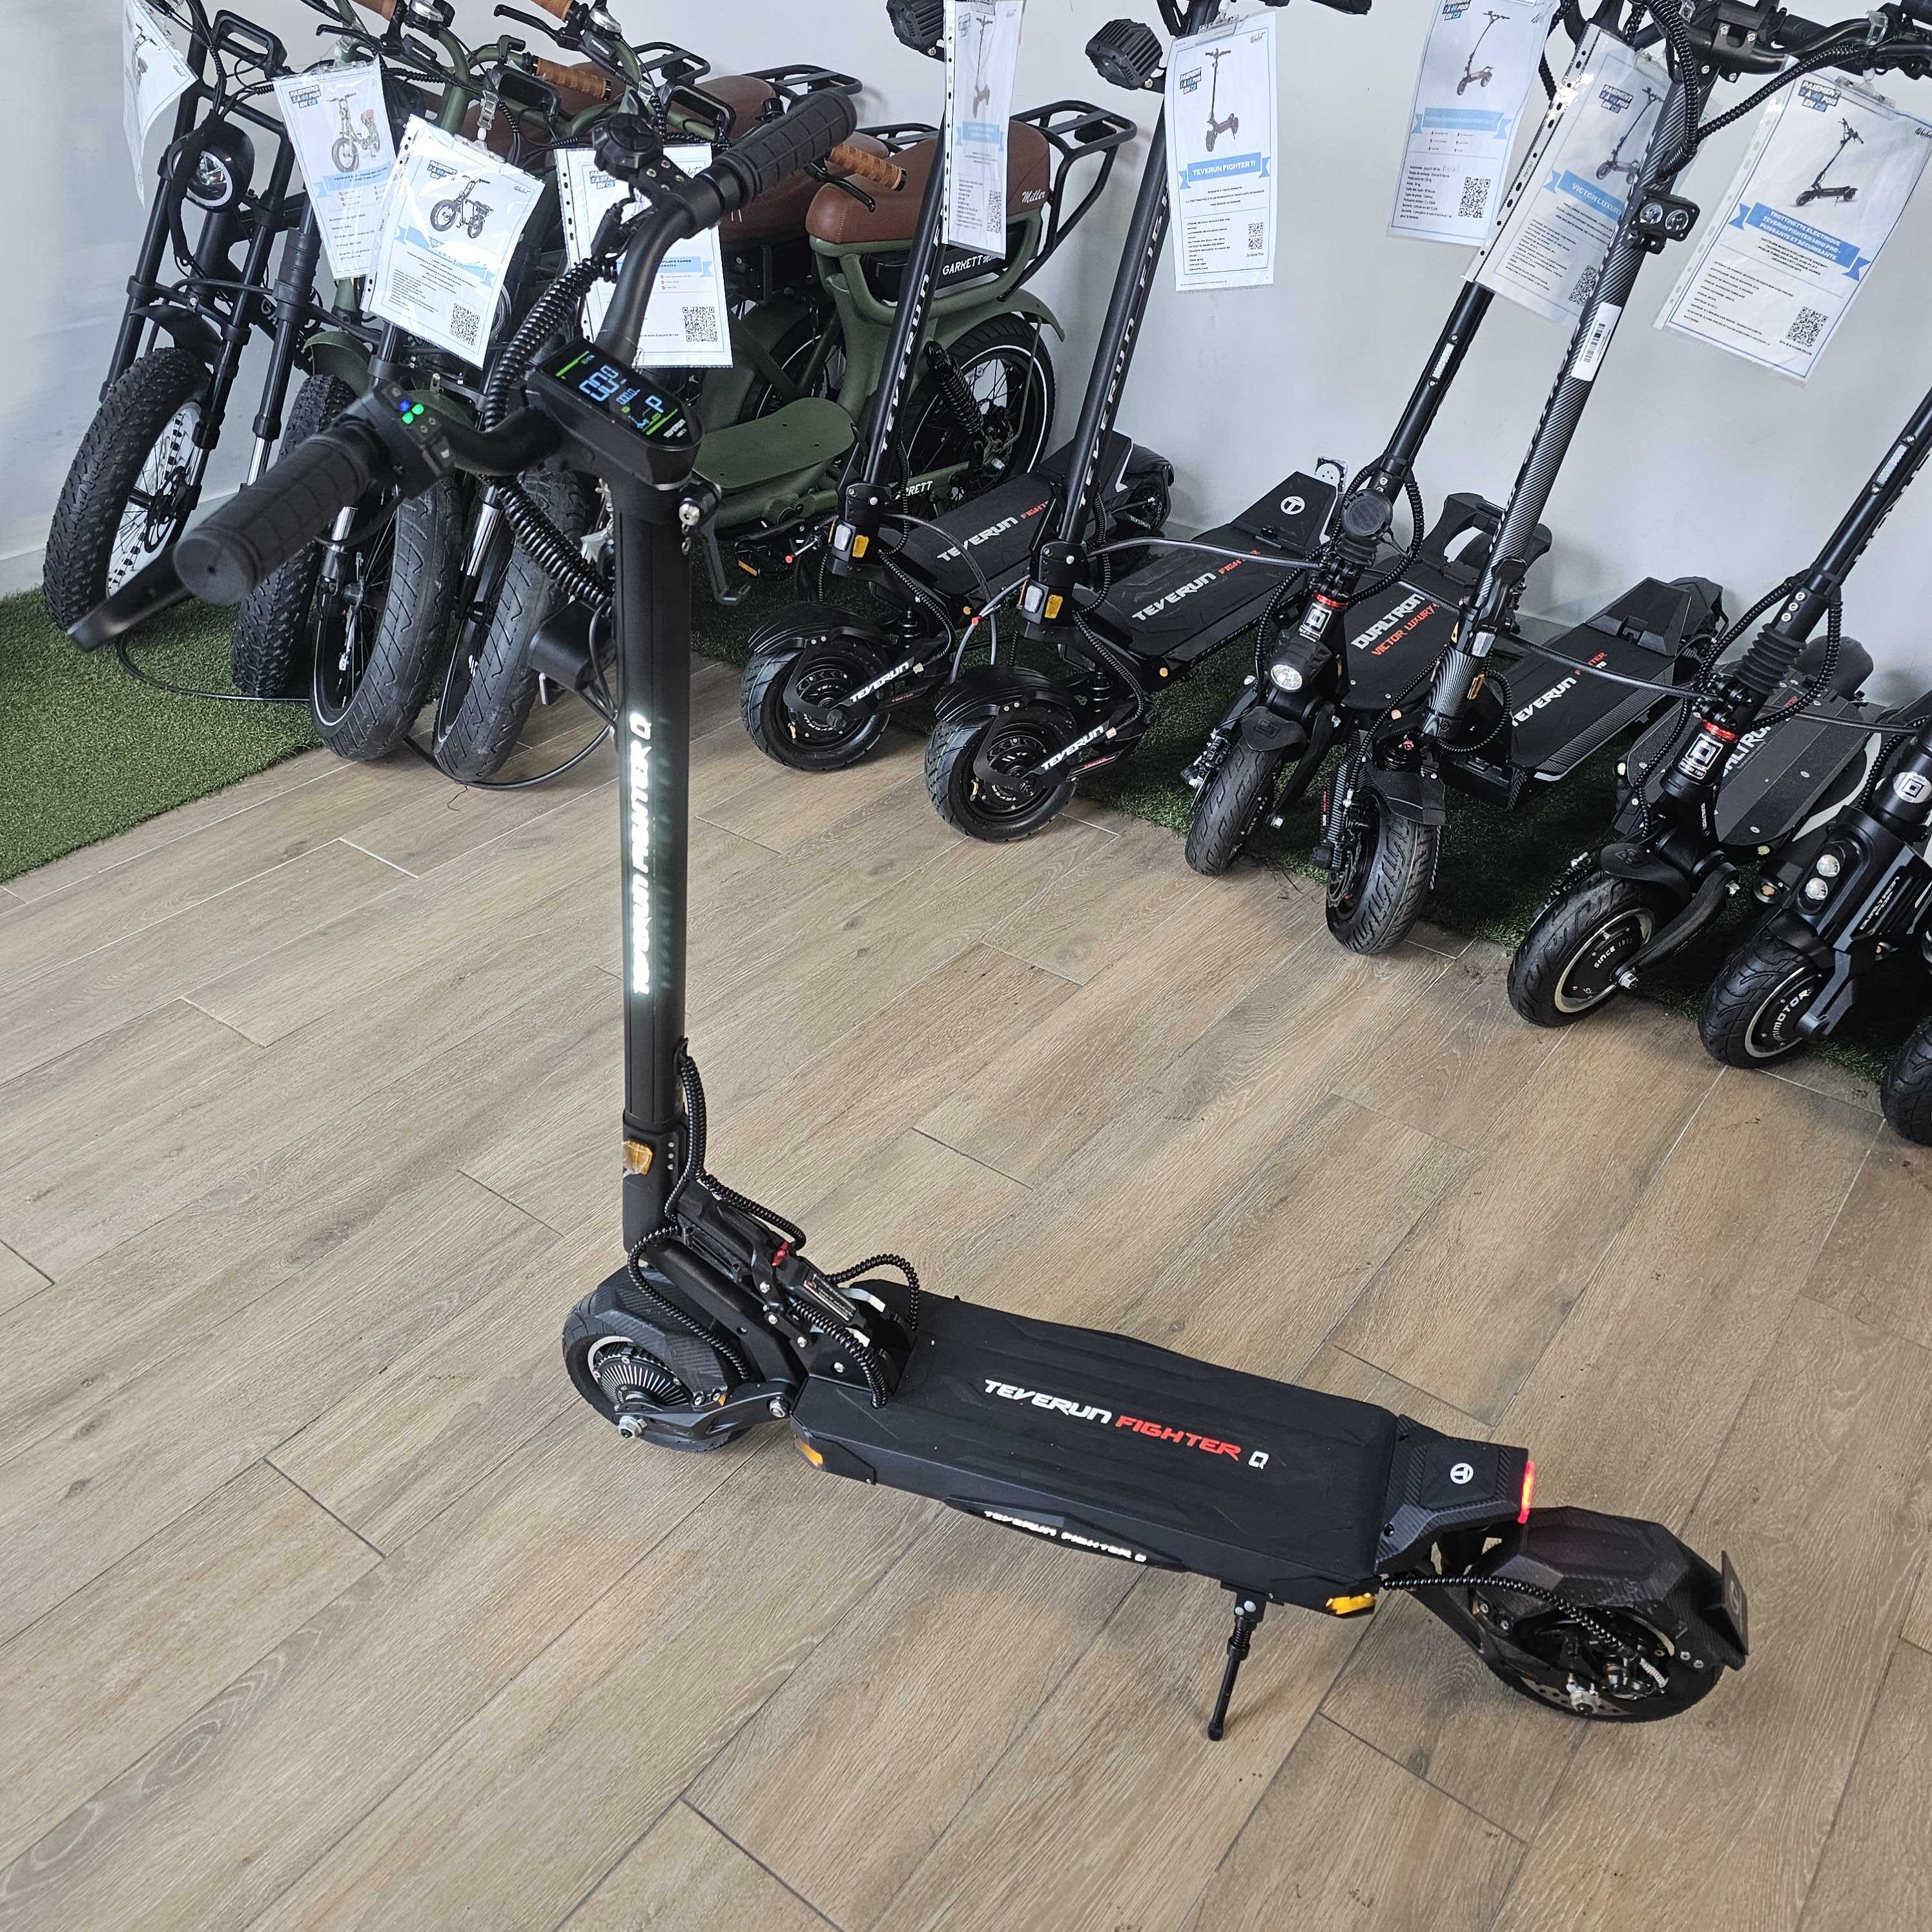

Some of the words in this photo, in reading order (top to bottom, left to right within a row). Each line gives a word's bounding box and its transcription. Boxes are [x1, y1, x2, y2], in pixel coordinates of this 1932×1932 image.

[1802, 81, 1841, 98] PAIEMENT
[1803, 99, 1816, 108] EN
[1821, 96, 1838, 106] FOIS
[1193, 165, 1222, 176] TEVERUN
[1222, 161, 1250, 171] FIGHTER
[1022, 189, 1045, 203] Miller
[1572, 182, 1597, 203] VICTOR
[1762, 216, 1789, 232] TEVERUN
[1770, 211, 1807, 231] TROTTINETTE
[1806, 225, 1842, 246] ÉLECTRIQUE
[880, 273, 930, 454] TEVERUN
[1078, 317, 1135, 510] TEVERUN
[1020, 500, 1049, 520] FIGHT
[1131, 571, 1217, 622] TEVERUN
[1350, 593, 1426, 650] DUALTRON
[1371, 630, 1408, 657] VICTOR
[849, 661, 909, 703] TEVERUN
[1041, 725, 1104, 771] TEVERUN
[984, 1379, 1113, 1424] TEVERUN
[1115, 1415, 1243, 1462] FIGHTER
[1248, 1450, 1270, 1470] Q
[983, 1510, 1058, 1537] TEVERUN
[1060, 1530, 1133, 1560] FIGHTER
